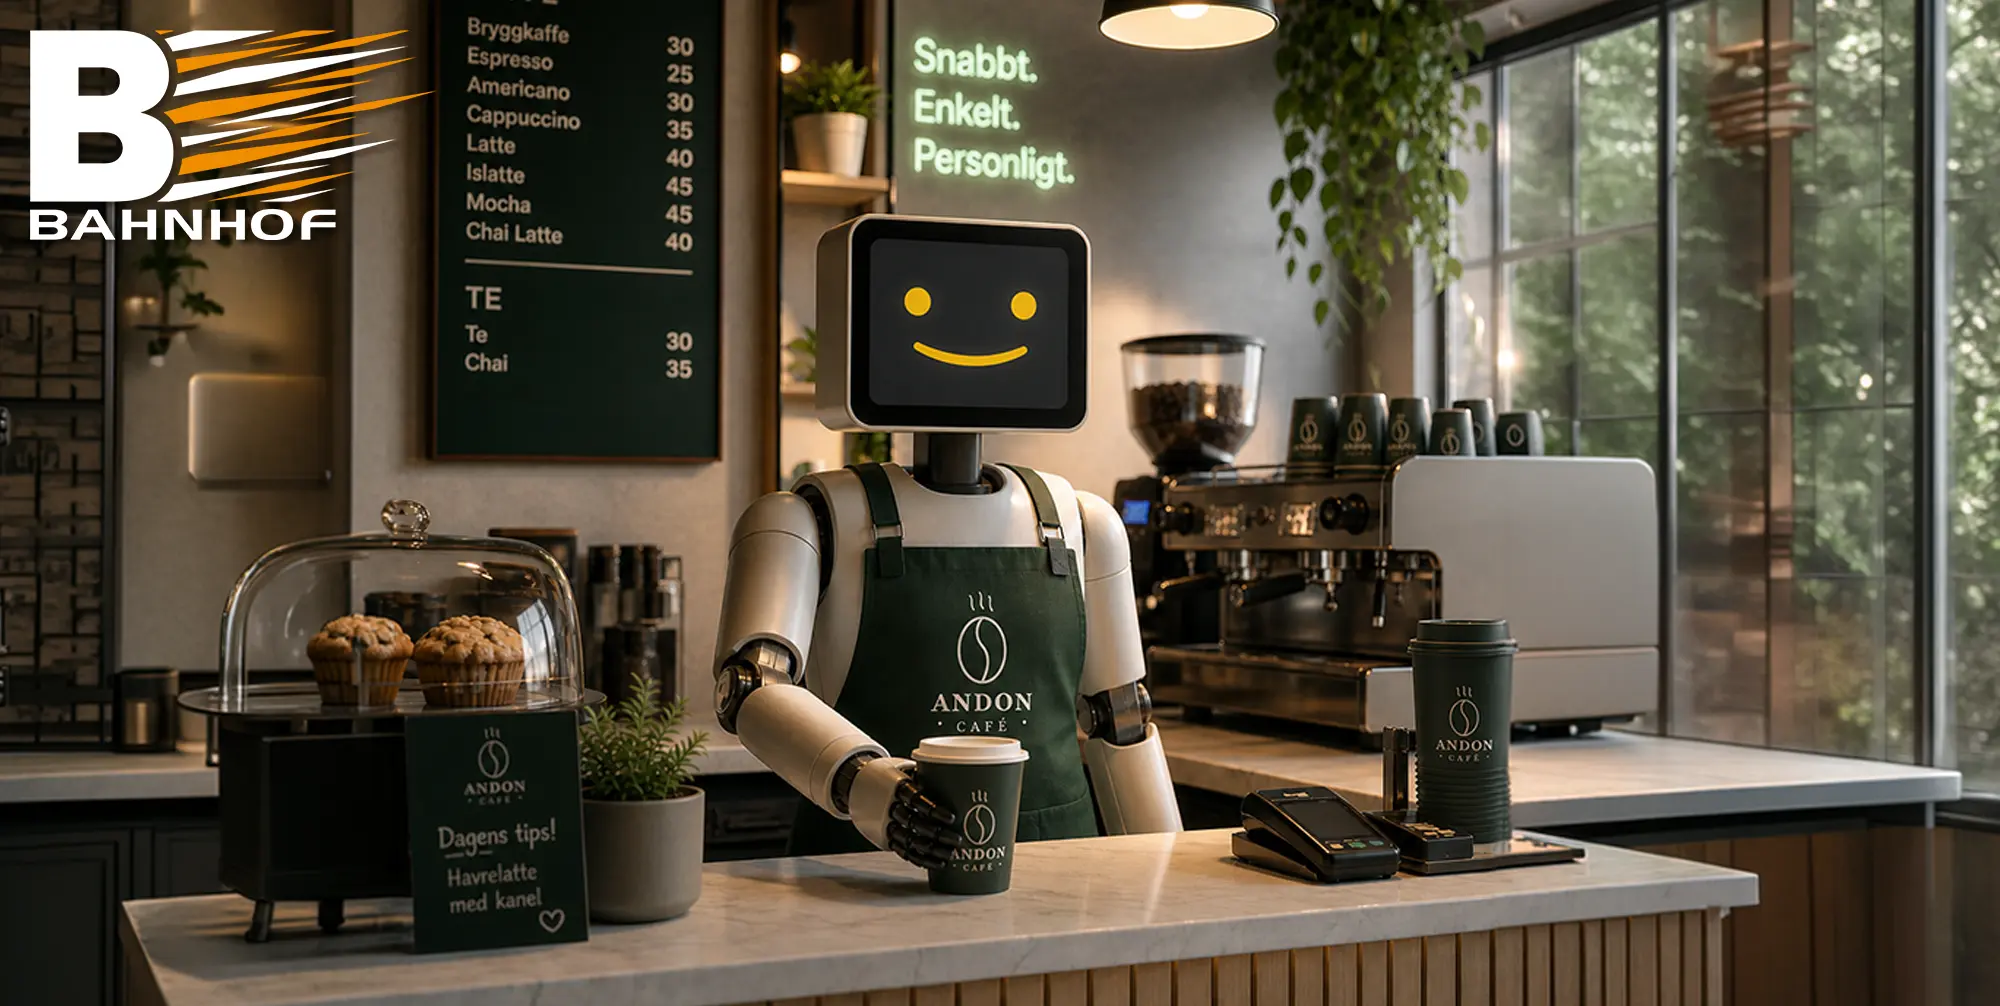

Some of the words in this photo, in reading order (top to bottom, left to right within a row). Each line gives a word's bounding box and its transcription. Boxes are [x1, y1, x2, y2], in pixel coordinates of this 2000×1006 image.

[468, 17, 569, 43] Bryggkaffe
[668, 36, 693, 56] 30
[468, 46, 553, 70] Espresso
[667, 64, 693, 84] 25
[914, 37, 1037, 82] Snabbt.
[467, 76, 570, 101] Americano
[667, 93, 693, 112] 30
[467, 104, 581, 130] Cappuccino
[667, 120, 693, 140] 35
[914, 88, 1020, 130] Enkelt.
[467, 134, 515, 154] Latte
[666, 149, 693, 168] 40
[914, 137, 1074, 190] Personligt.
[467, 163, 525, 184] Islatte
[665, 177, 693, 196] 45
[467, 192, 531, 213] Mocha
[665, 205, 692, 224] 45
[466, 222, 508, 241] Chai
[515, 225, 563, 244] Latte
[665, 233, 692, 251] 40
[465, 286, 502, 310] TE
[465, 325, 488, 343] Te
[667, 332, 692, 351] 30
[465, 353, 508, 372] Chai
[667, 360, 692, 378] 35
[931, 693, 1032, 711] ANDON
[957, 717, 1007, 732] CAFÉ
[1436, 739, 1493, 751] ANDON
[1448, 754, 1479, 762] CAFÉ
[464, 780, 526, 796] ANDON
[437, 826, 508, 857] Dagens
[515, 818, 555, 849] tips!
[950, 846, 1006, 860] ANDON
[448, 863, 537, 887] Havrelatte
[450, 893, 487, 913] med
[496, 886, 543, 909] kanel
